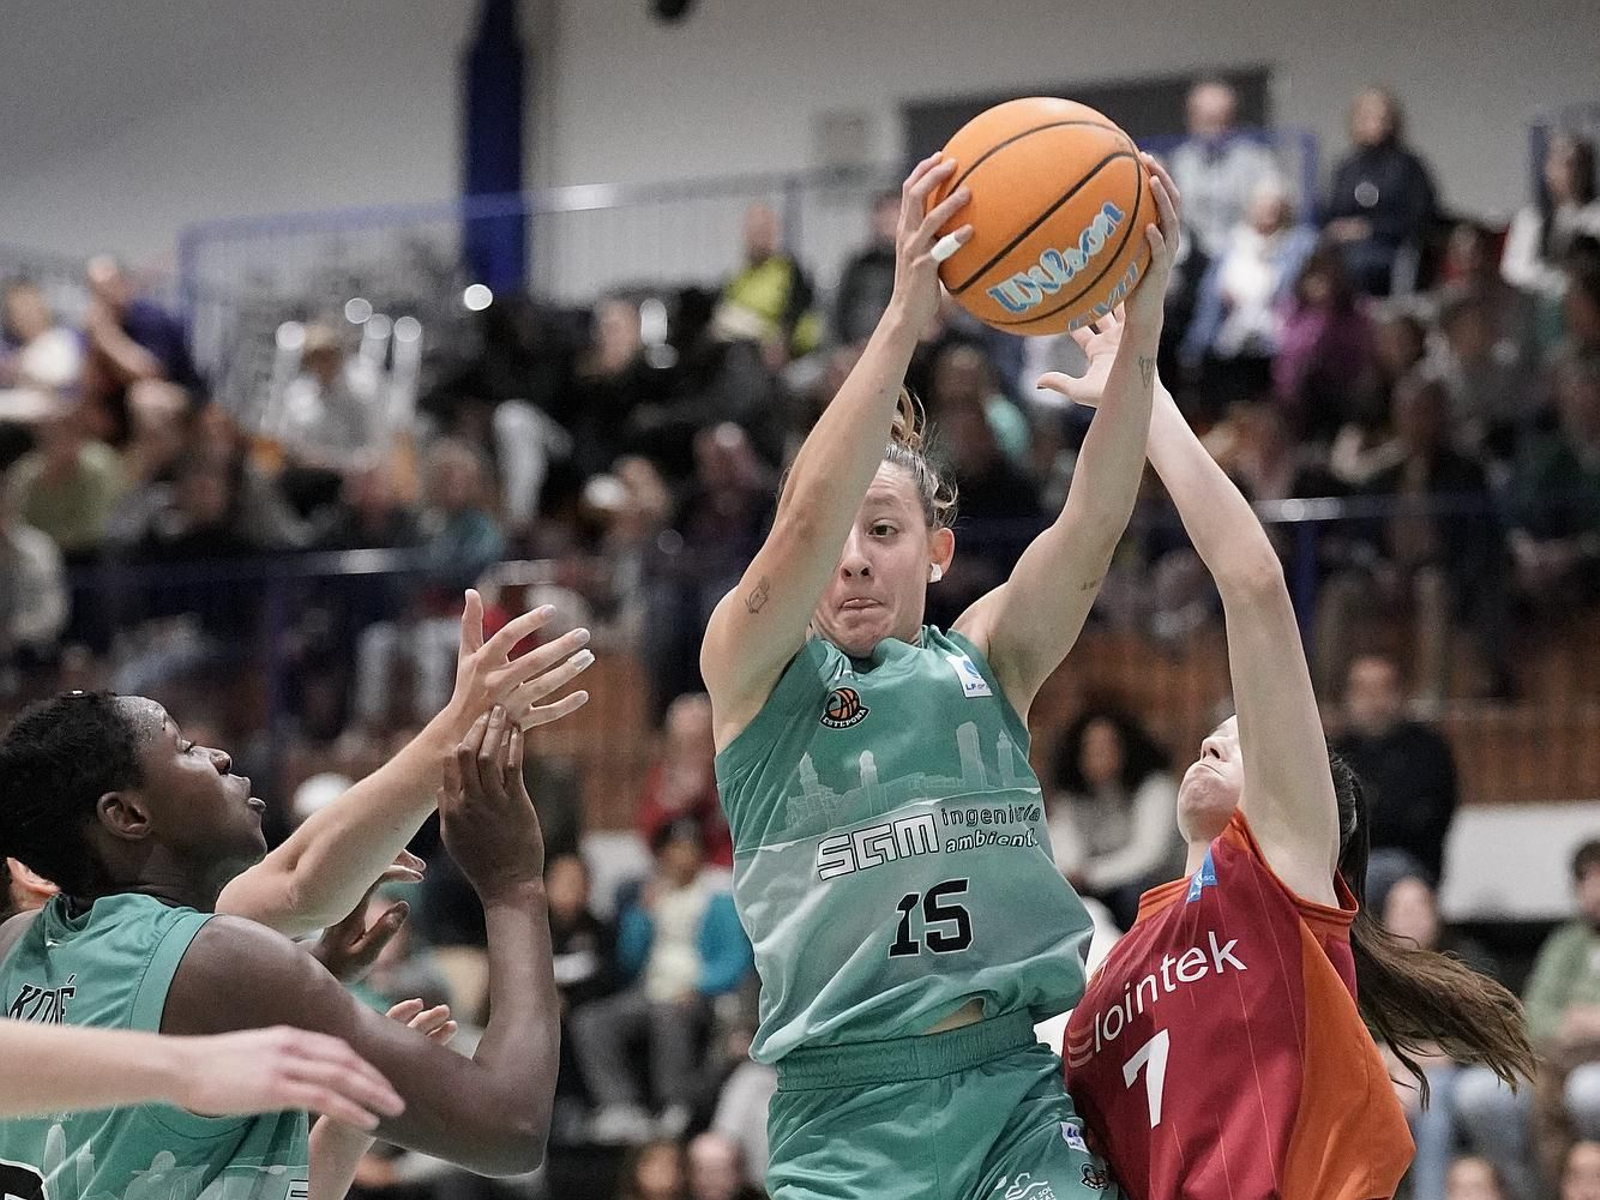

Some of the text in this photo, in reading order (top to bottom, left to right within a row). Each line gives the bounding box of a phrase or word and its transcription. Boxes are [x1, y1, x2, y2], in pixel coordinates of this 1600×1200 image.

[986, 201, 1125, 314] Wilson
[821, 708, 868, 728] ESTEPONA
[816, 813, 941, 881] SGM
[888, 878, 974, 959] 15
[1094, 931, 1248, 1053] lointek
[1122, 1028, 1170, 1130] 7
